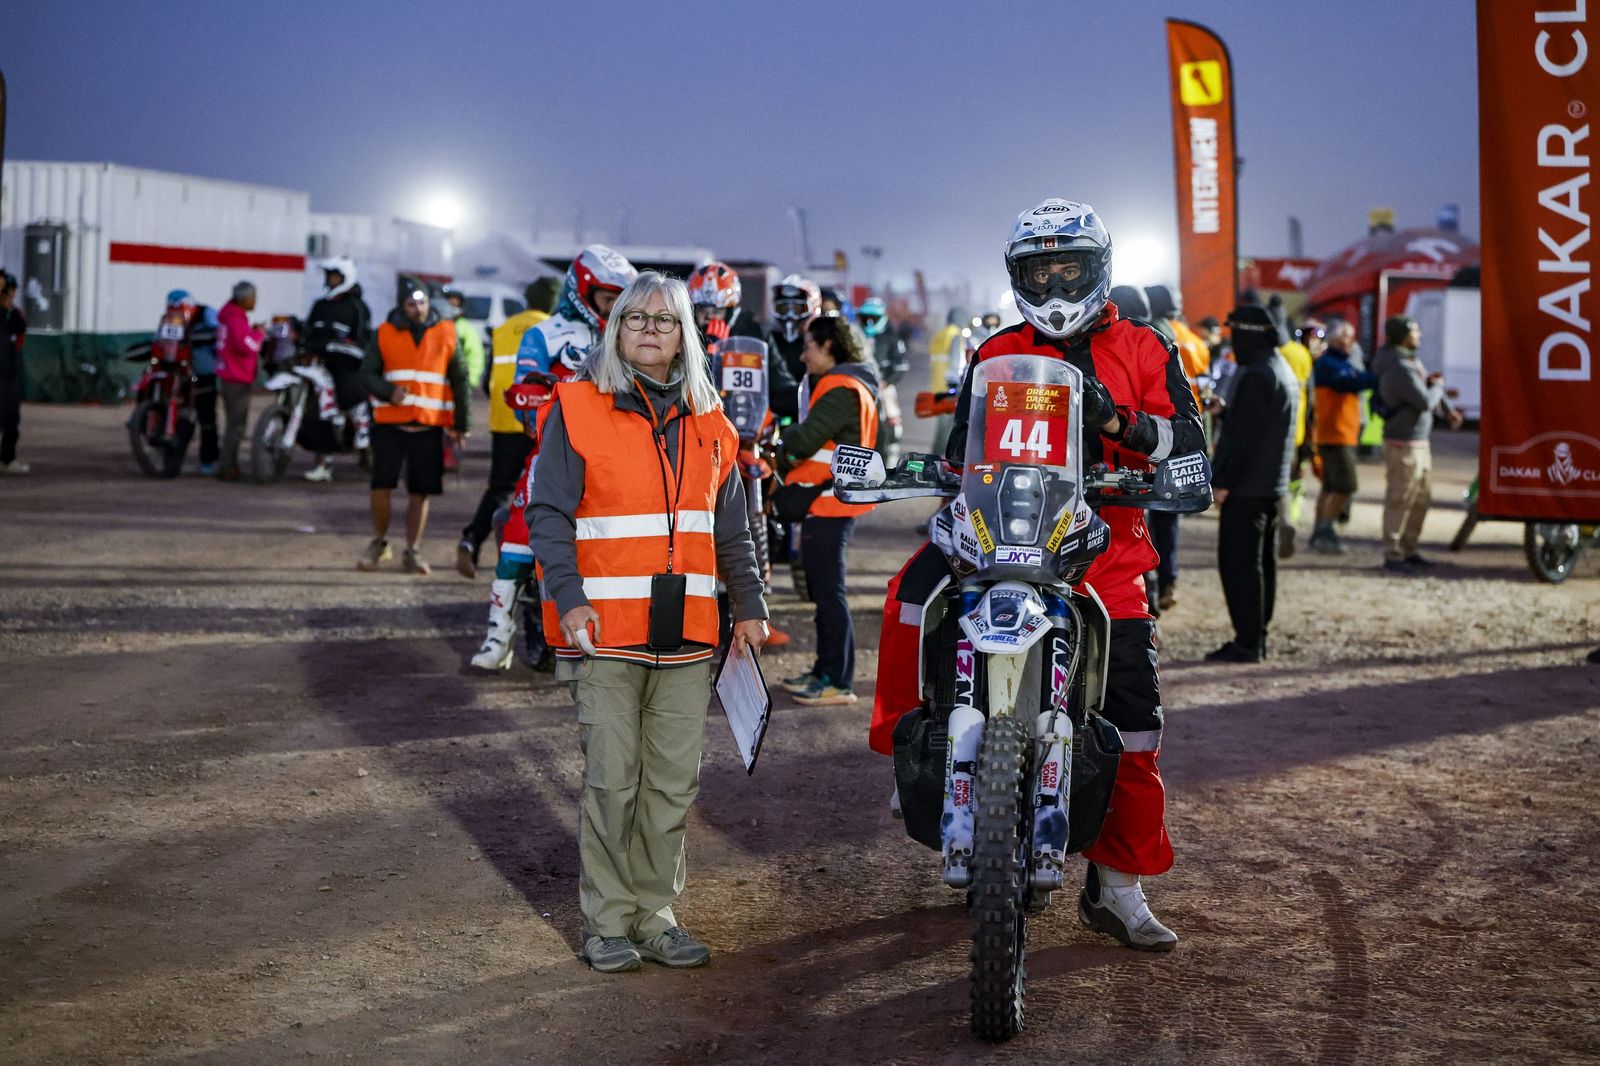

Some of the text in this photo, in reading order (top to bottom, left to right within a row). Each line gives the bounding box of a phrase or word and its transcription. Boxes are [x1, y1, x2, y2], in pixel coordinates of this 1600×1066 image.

[1537, 123, 1591, 381] DAKAR
[733, 370, 753, 388] 38
[1025, 395, 1052, 404] DARE.
[1026, 388, 1060, 398] DREAM.
[1025, 403, 1057, 412] LIVE IT.
[999, 419, 1052, 459] 44
[836, 456, 870, 467] RALLY
[836, 465, 867, 477] BIKES
[1171, 464, 1203, 478] RALLY
[1500, 466, 1541, 478] DAKAR
[1175, 473, 1206, 487] BIKES
[960, 532, 978, 548] RALLY
[1087, 525, 1106, 541] RALLY
[960, 541, 977, 557] BIKES
[1087, 534, 1104, 550] BIKES
[1049, 762, 1058, 789] ROJAS
